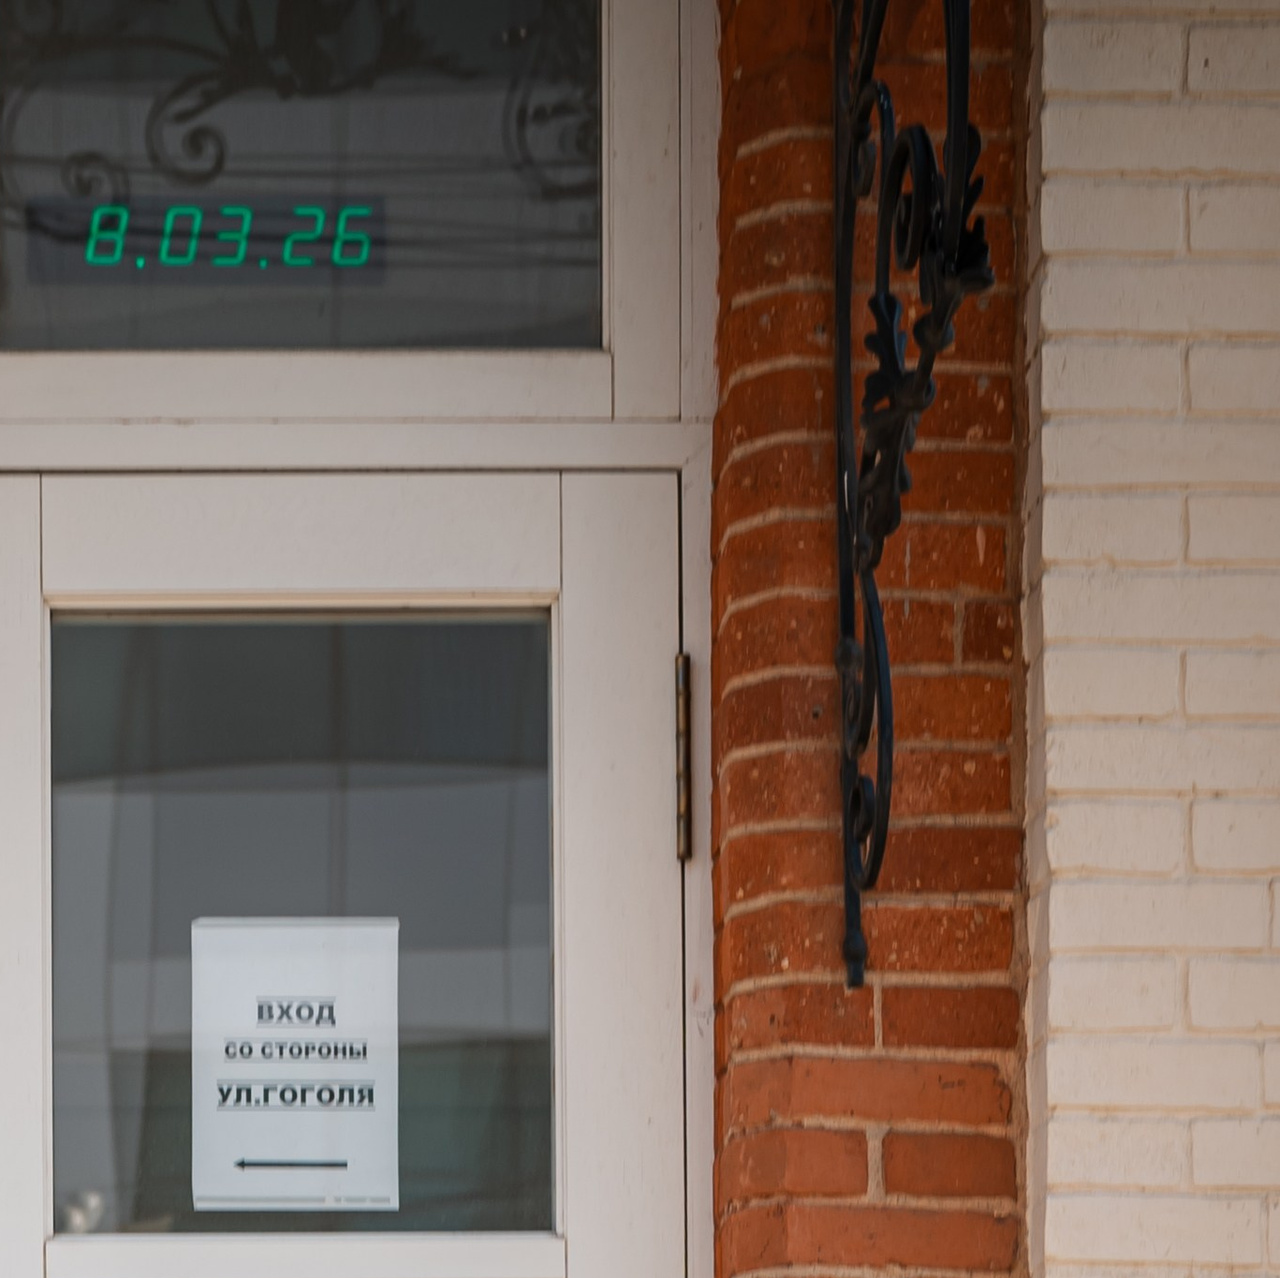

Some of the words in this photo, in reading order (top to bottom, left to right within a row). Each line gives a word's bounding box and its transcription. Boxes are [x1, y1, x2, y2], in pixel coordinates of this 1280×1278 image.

[84, 204, 372, 270] 8.03.26
[256, 1002, 336, 1026] ВХОД
[224, 1041, 253, 1060] СО
[260, 1041, 368, 1060] СТОРОНЫ
